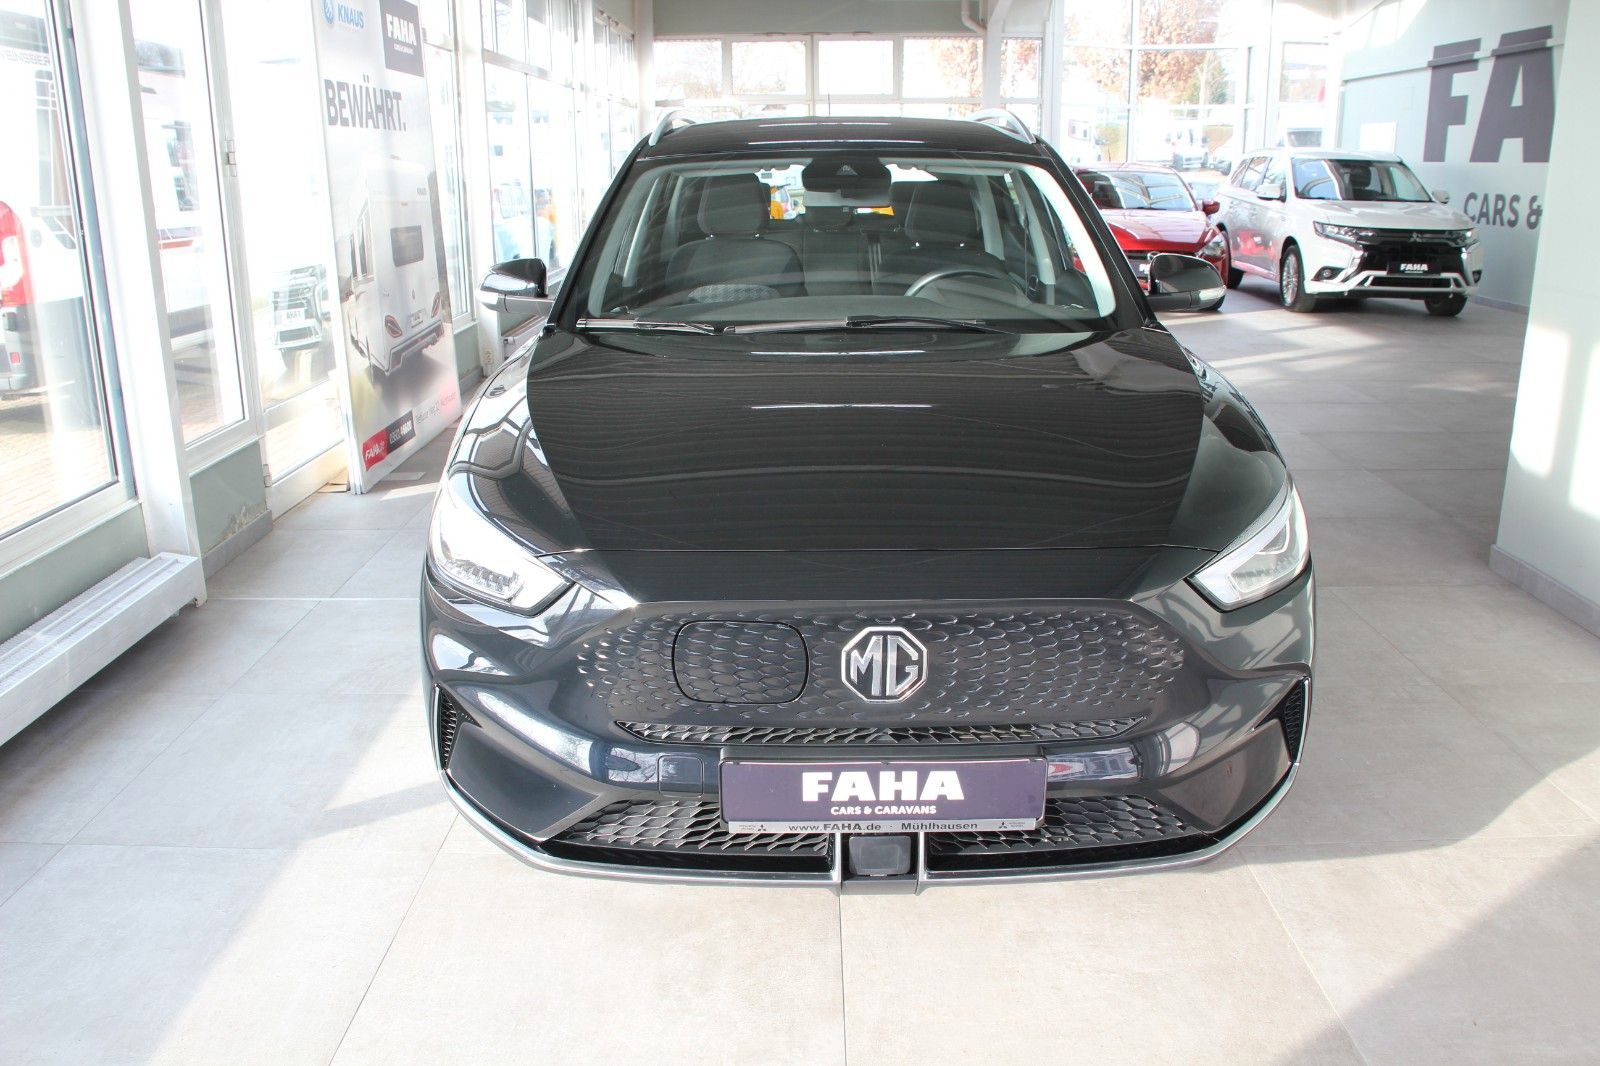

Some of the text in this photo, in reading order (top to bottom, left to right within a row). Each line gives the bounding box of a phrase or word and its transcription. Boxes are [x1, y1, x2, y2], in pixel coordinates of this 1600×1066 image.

[337, 4, 364, 28] KNAUS
[385, 13, 417, 46] FAHA
[324, 74, 406, 131] BEWÄHRT.
[1463, 192, 1543, 230] CARS &
[1400, 263, 1428, 271] FAHA
[848, 632, 922, 699] MG
[802, 770, 965, 802] FAHA
[830, 805, 936, 815] CARS & CARAVANS
[788, 822, 978, 832] www.FAHA.de Mühlhausen
